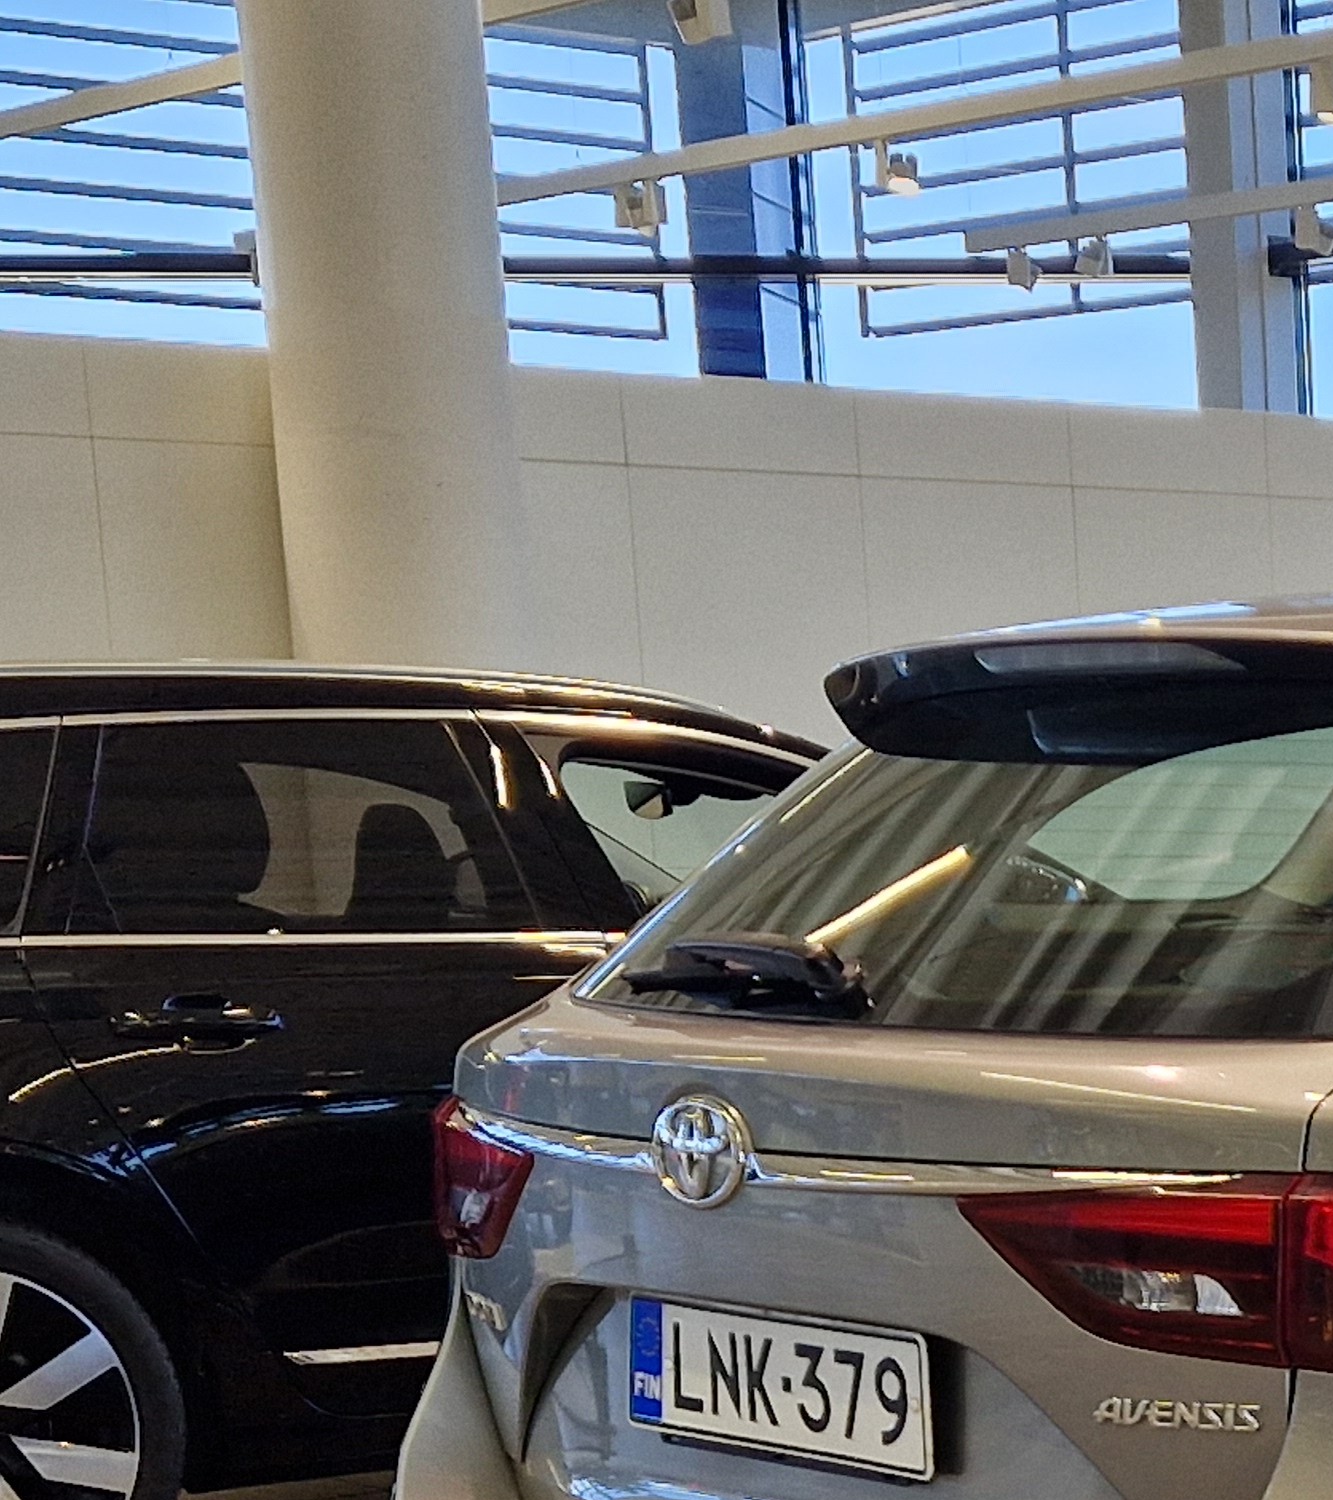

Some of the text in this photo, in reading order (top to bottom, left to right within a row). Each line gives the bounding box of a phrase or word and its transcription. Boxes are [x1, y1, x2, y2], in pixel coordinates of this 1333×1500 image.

[632, 1320, 909, 1446] FIN LNK-379
[1092, 1396, 1261, 1431] AVENSIS
